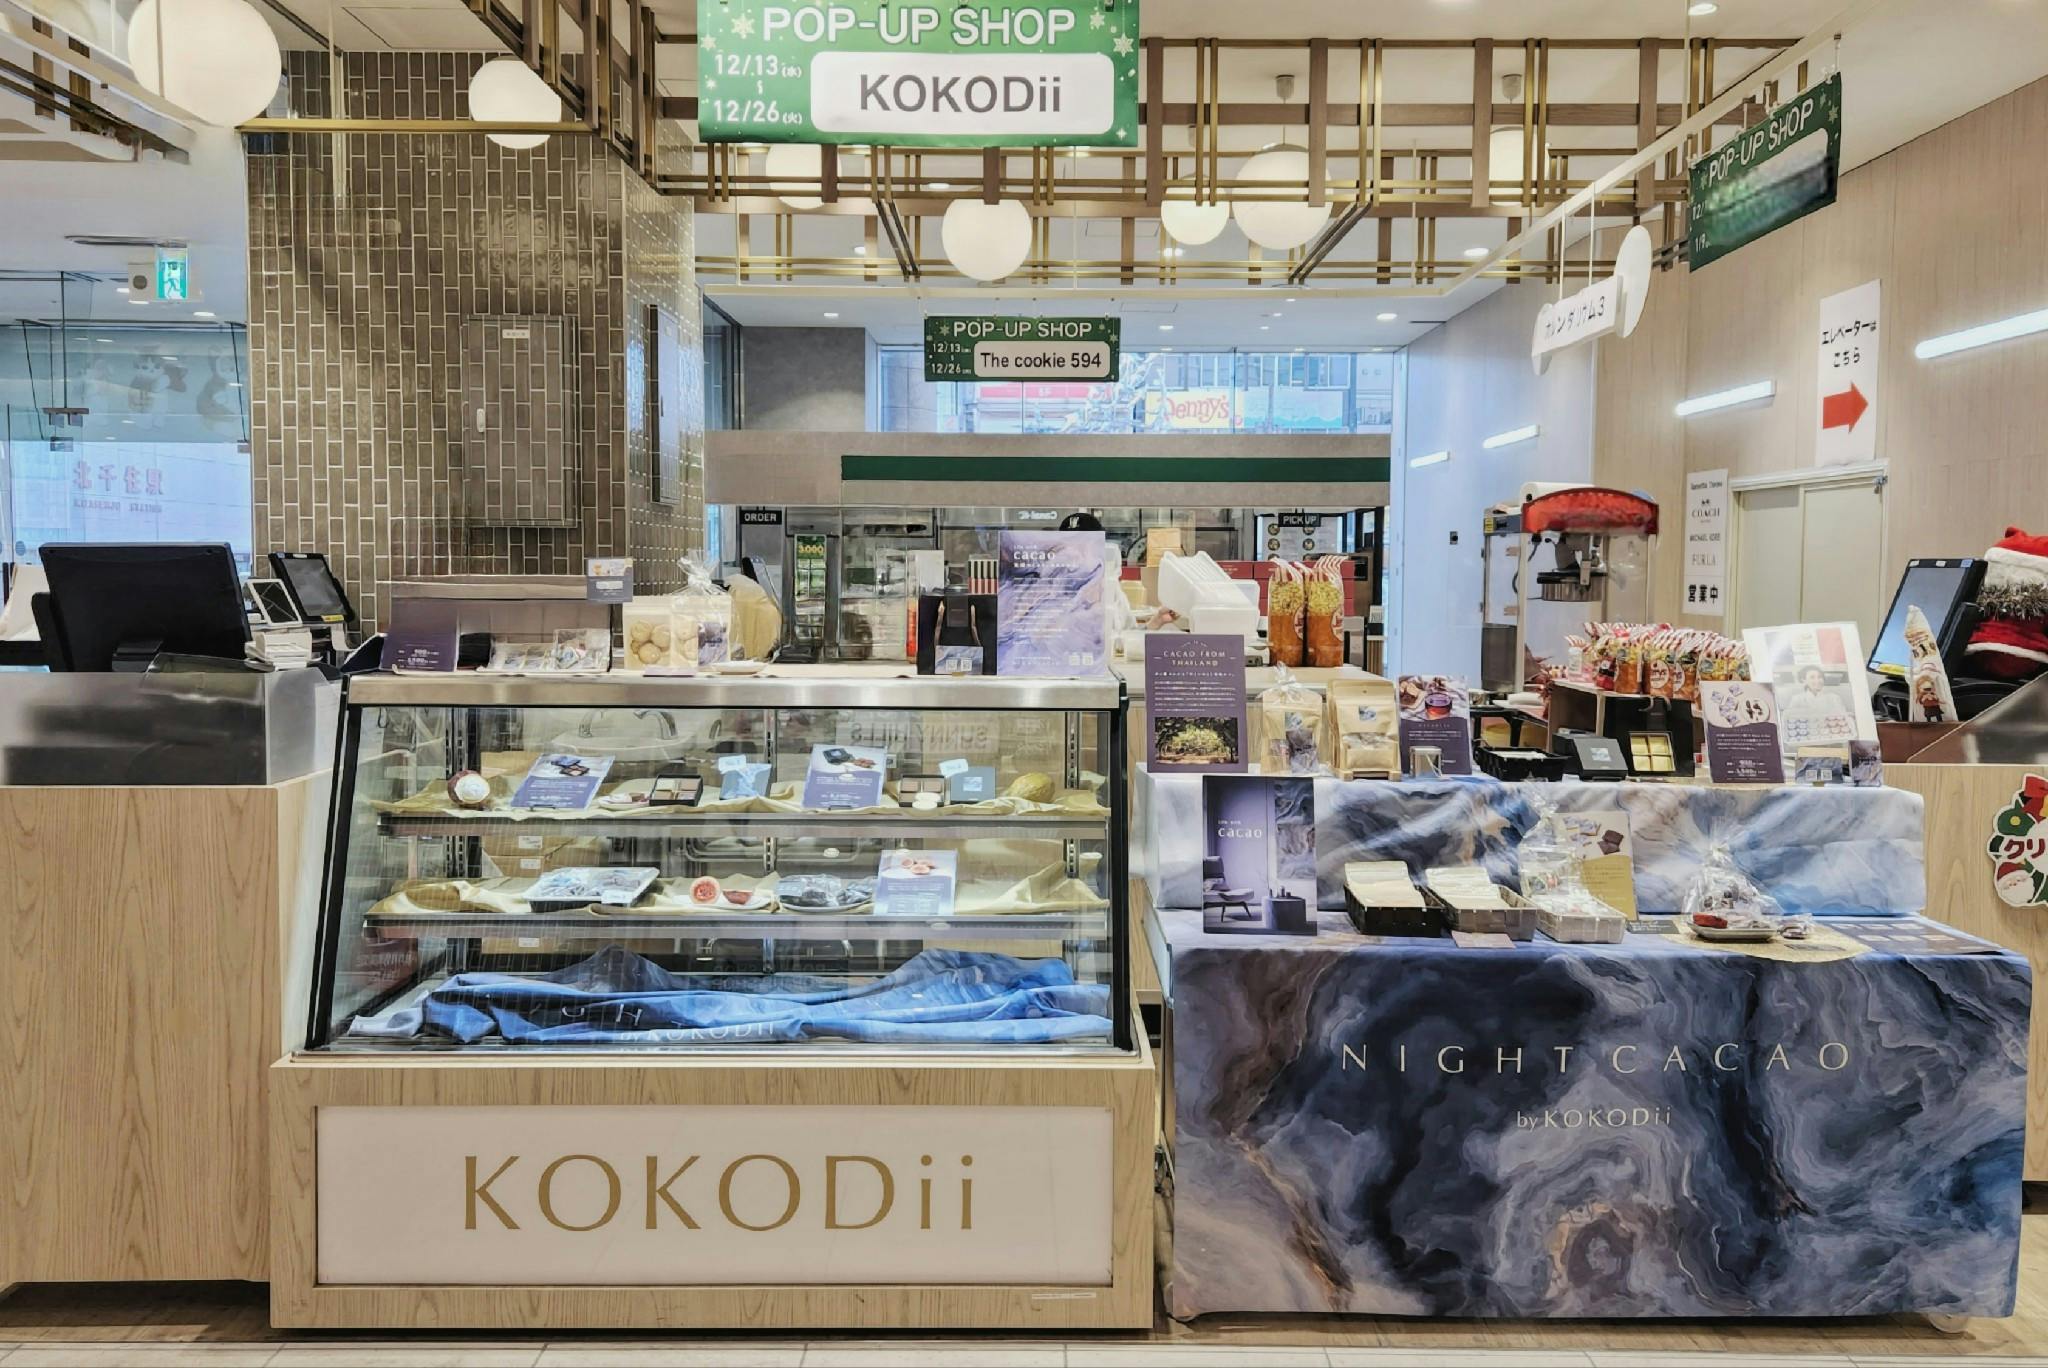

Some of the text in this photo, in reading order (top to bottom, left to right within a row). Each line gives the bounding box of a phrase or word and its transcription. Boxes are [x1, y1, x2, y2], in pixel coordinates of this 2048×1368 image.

[762, 7, 1076, 45] POP-UP SHOP
[860, 74, 1061, 113] KOKODii
[1709, 101, 1814, 183] POP-UP SHOP
[953, 321, 1092, 338] POP-UP SHOP
[980, 352, 1101, 368] The cookie 594
[744, 513, 777, 522] ORDER
[1283, 515, 1318, 525] PICK UP
[1013, 550, 1056, 561] cacao
[1217, 827, 1262, 838] cacao
[1341, 1042, 1850, 1074] NIGHT CACAO
[1516, 1106, 1672, 1131] by KOKODii
[464, 1154, 975, 1232] KOKODii
